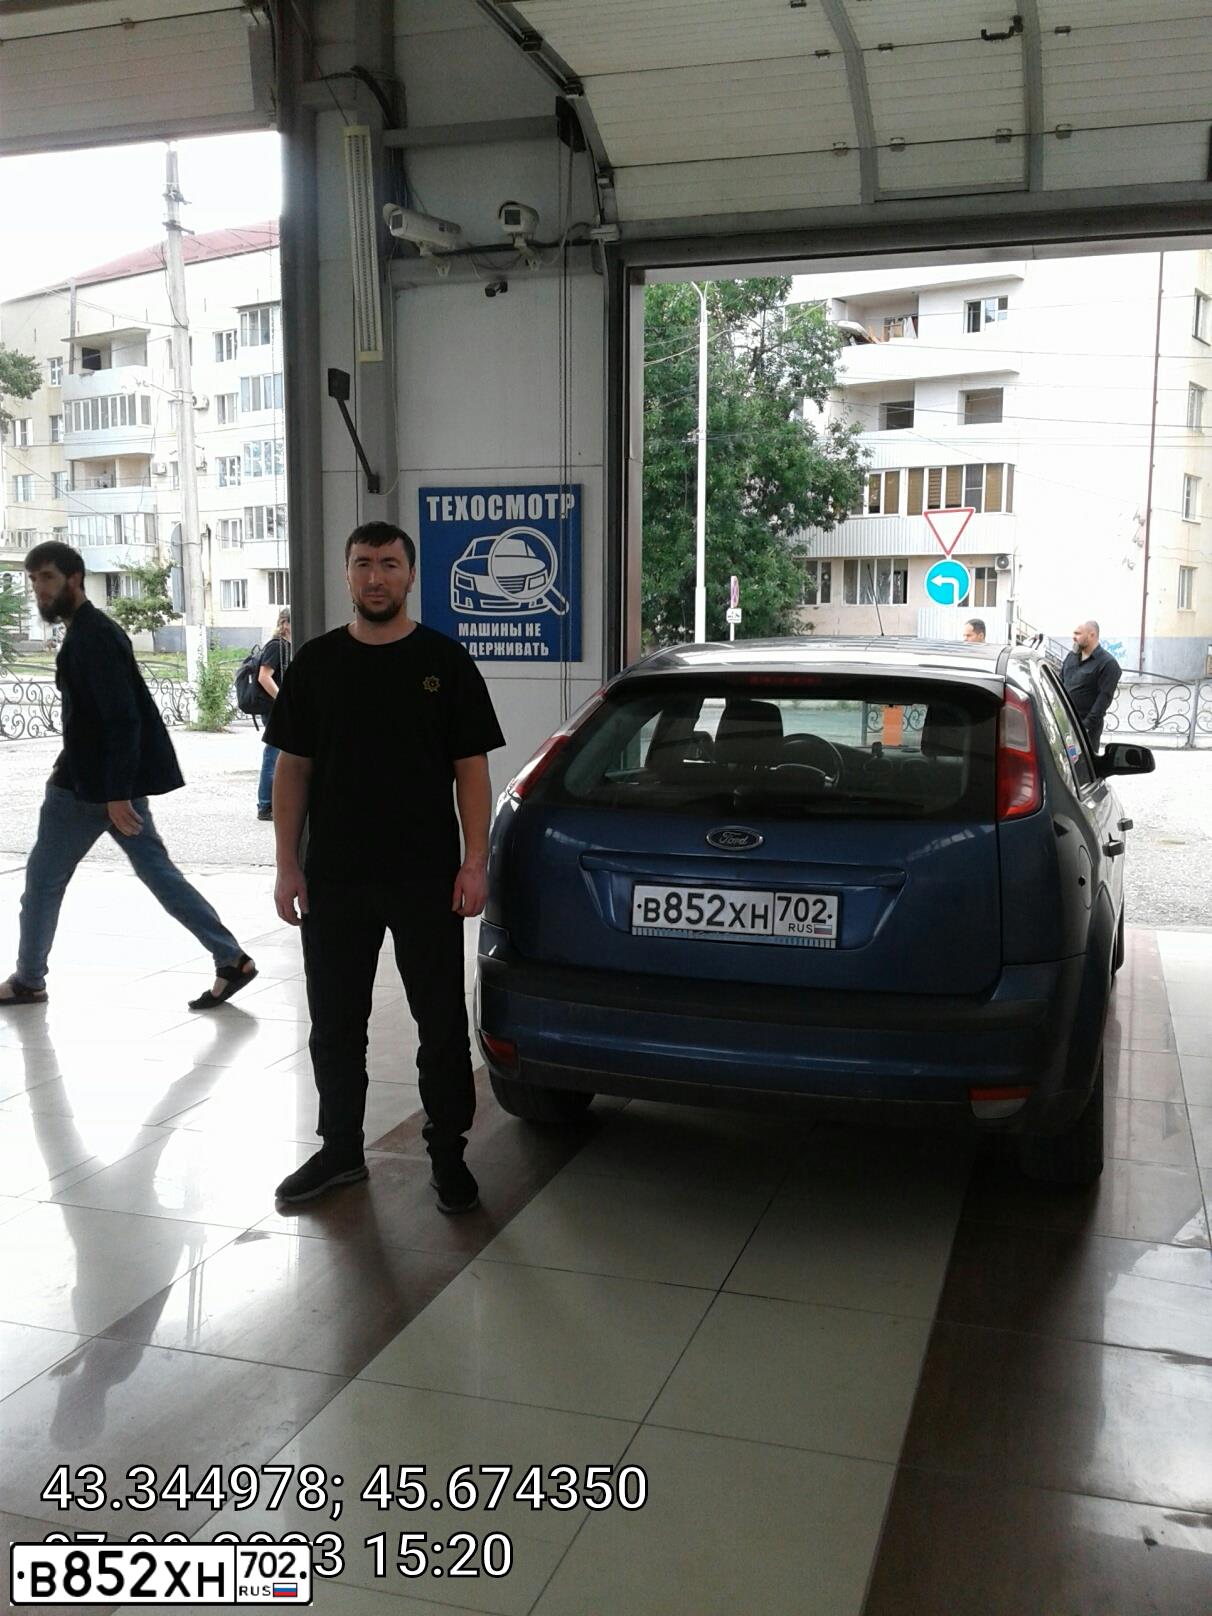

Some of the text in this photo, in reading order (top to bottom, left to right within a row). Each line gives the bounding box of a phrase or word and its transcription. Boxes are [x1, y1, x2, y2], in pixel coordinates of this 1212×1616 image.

[426, 493, 576, 522] ТЕХОСМОТР
[458, 622, 542, 637] МАШИНЫ НЕ
[461, 641, 550, 658] ДЕРЖИВАТЬ
[719, 831, 749, 845] Ford
[777, 896, 827, 924] 702
[788, 922, 813, 934] RUS
